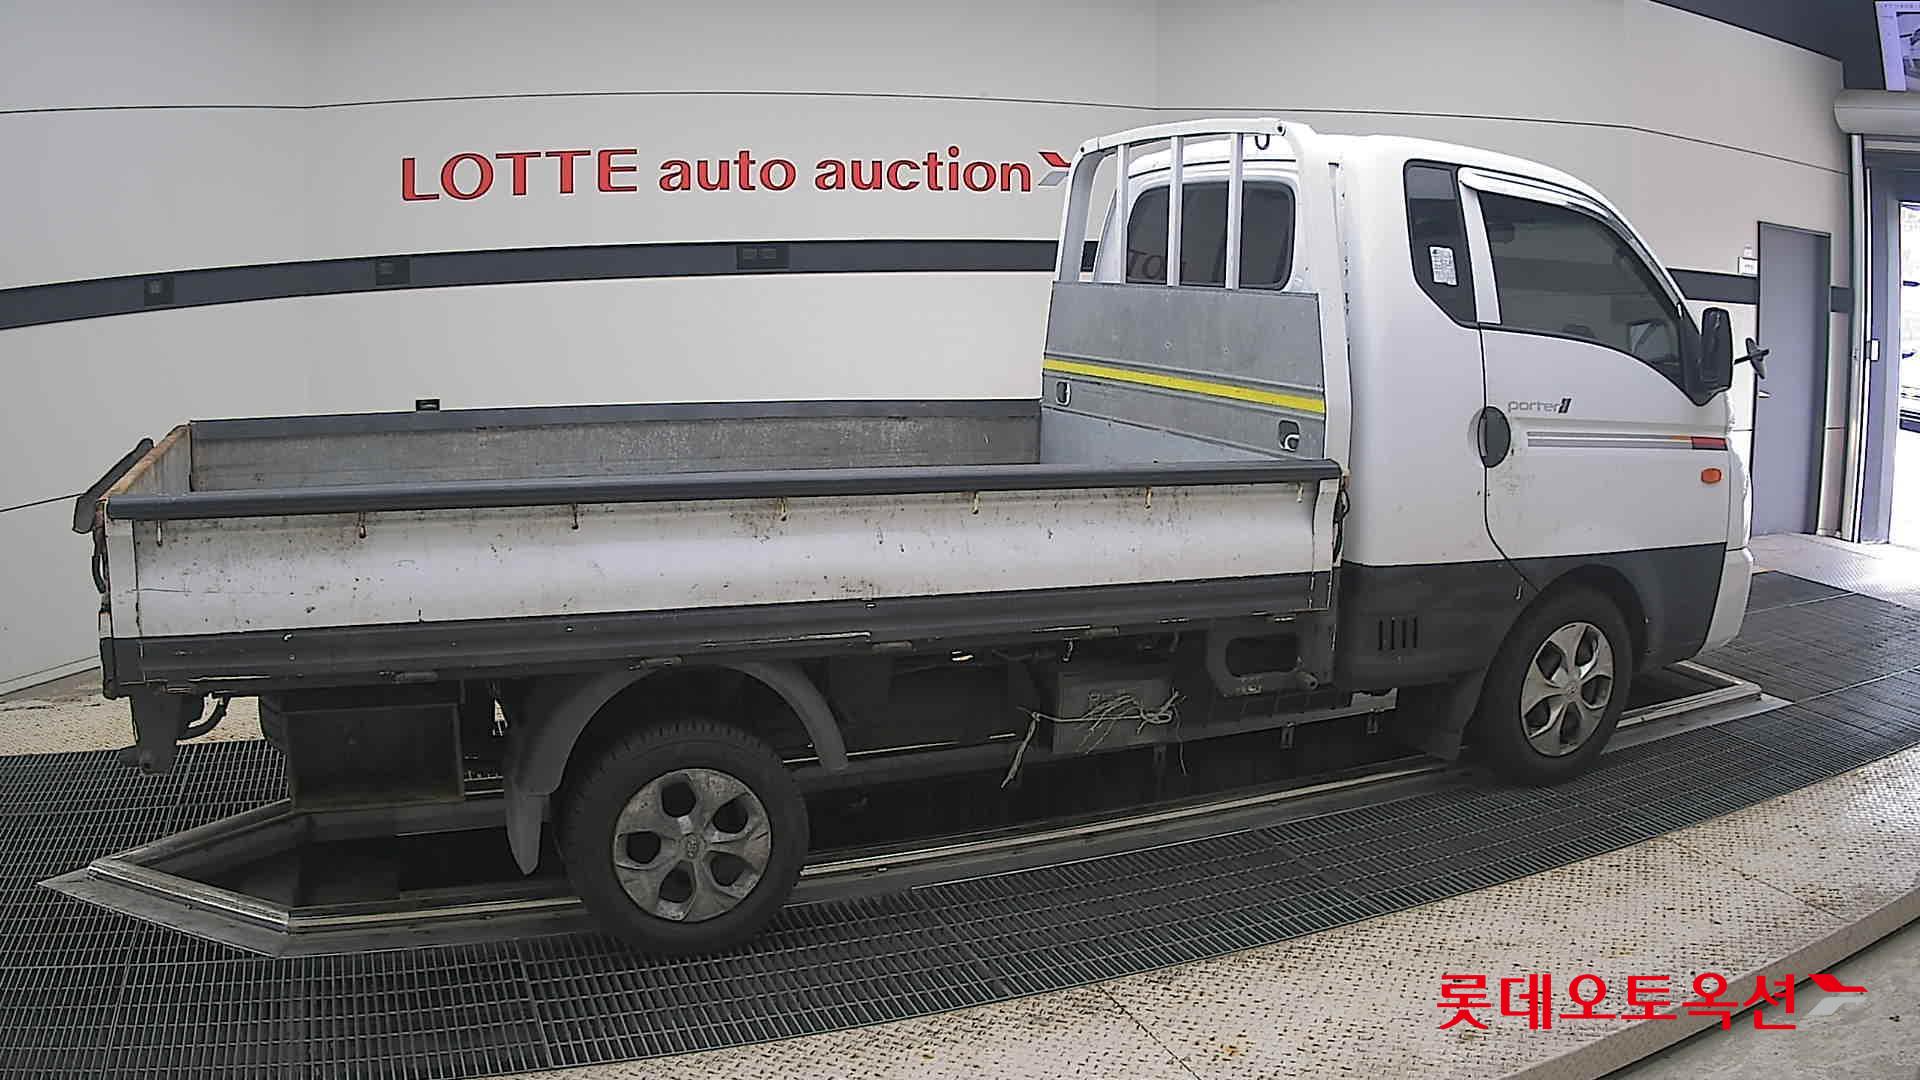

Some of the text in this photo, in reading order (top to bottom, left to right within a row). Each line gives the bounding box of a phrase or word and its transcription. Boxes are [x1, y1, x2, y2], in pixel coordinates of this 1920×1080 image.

[402, 146, 1032, 201] LOTTE auto auction
[1508, 400, 1560, 413] porter
